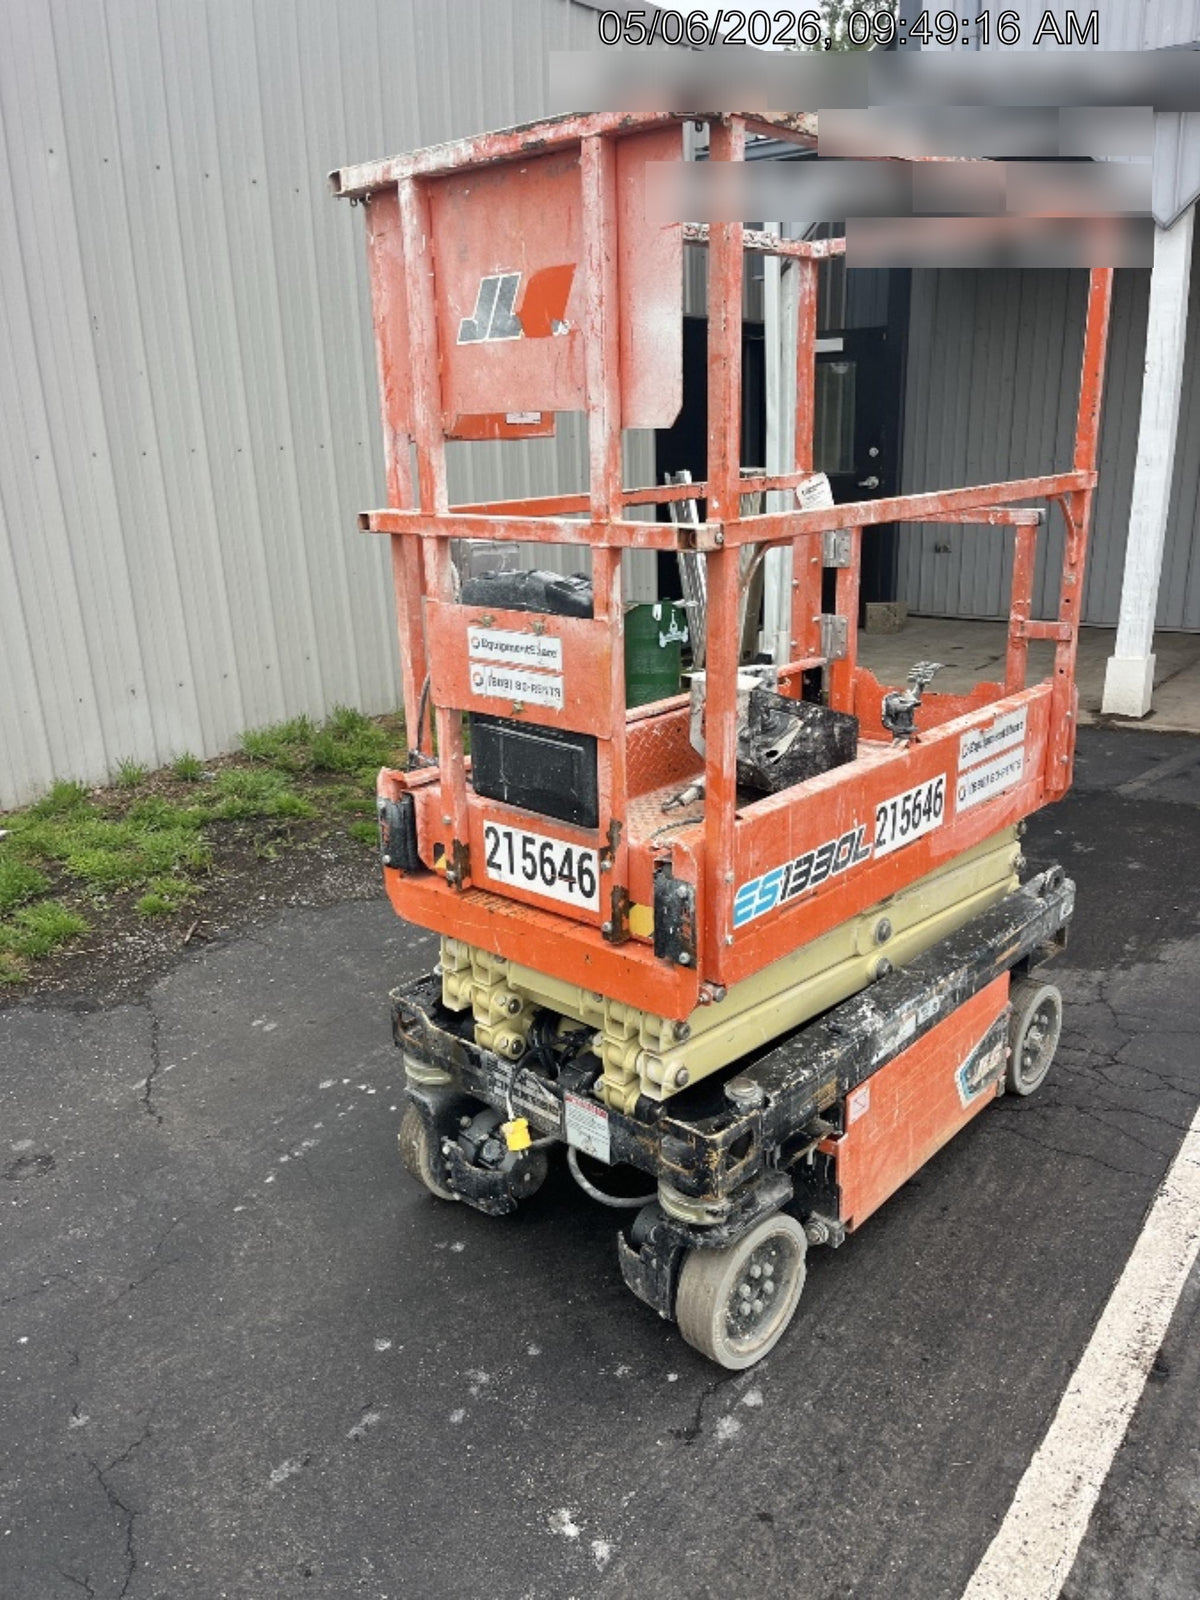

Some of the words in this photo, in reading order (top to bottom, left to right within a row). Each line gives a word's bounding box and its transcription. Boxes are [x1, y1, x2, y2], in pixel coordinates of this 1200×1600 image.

[875, 778, 944, 849] 215646
[485, 826, 597, 899] 215646
[734, 826, 871, 928] ES1330L
